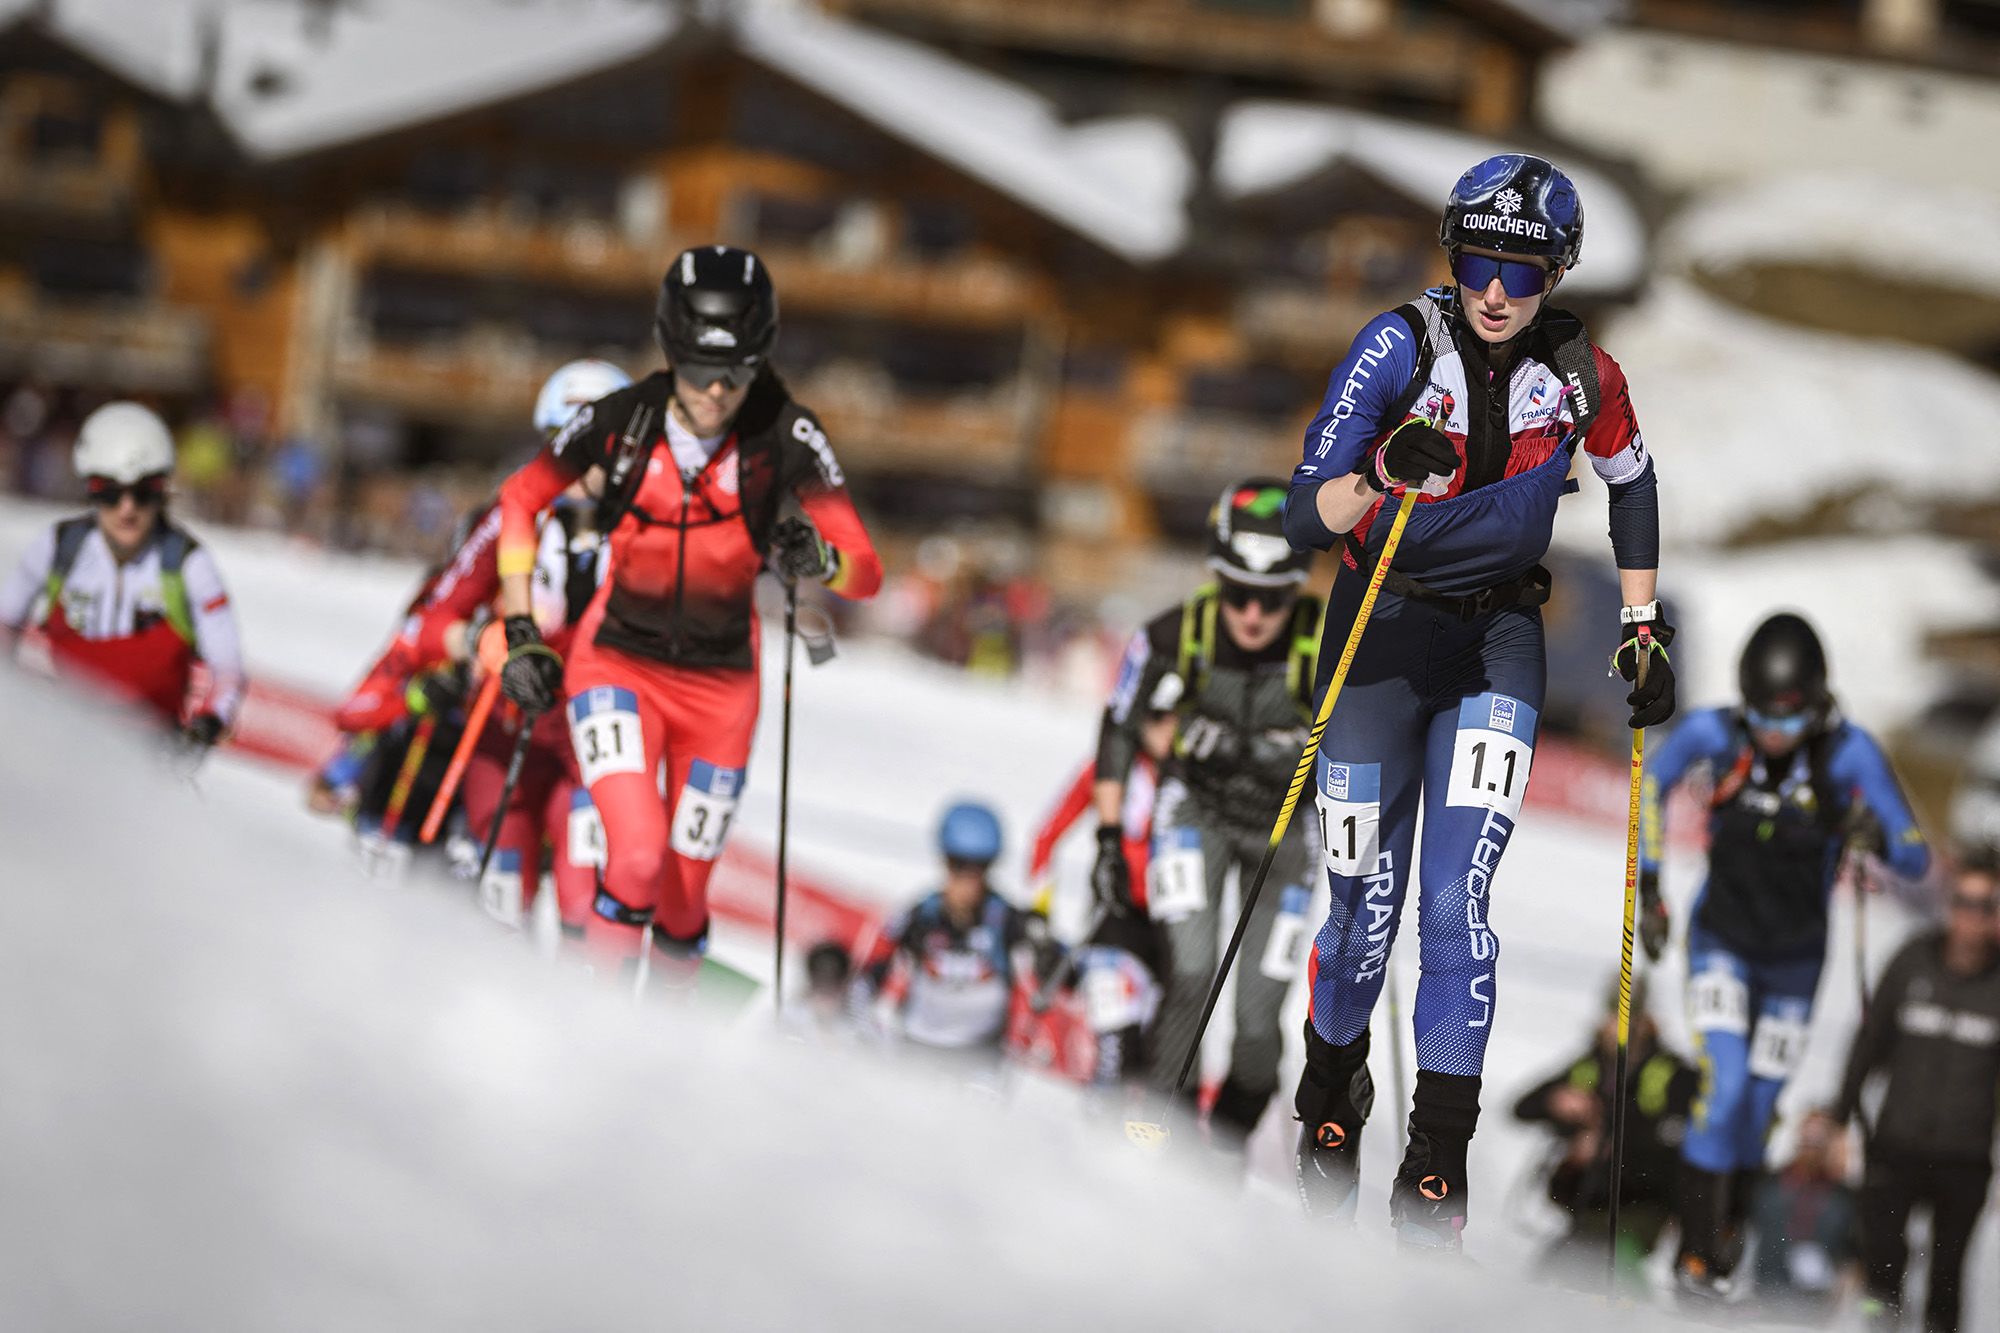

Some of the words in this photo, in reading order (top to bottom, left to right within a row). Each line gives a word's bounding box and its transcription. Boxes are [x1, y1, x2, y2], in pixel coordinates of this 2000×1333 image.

[1463, 213, 1548, 240] COURCHEVEL
[1315, 326, 1405, 459] SPORTIVA
[1567, 372, 1588, 417] MILLET
[1354, 590, 1379, 639] CARBON
[1338, 641, 1358, 677] POLES
[1493, 709, 1512, 719] ISMF
[585, 722, 622, 763] 3.1
[1471, 742, 1517, 798] 1.1
[1630, 776, 1641, 809] POLES
[687, 805, 732, 846] 3.1
[1321, 807, 1356, 860] 1.1
[1627, 857, 1637, 877] ATK
[1355, 850, 1394, 983] FRANCE
[1468, 973, 1489, 1027] LA
